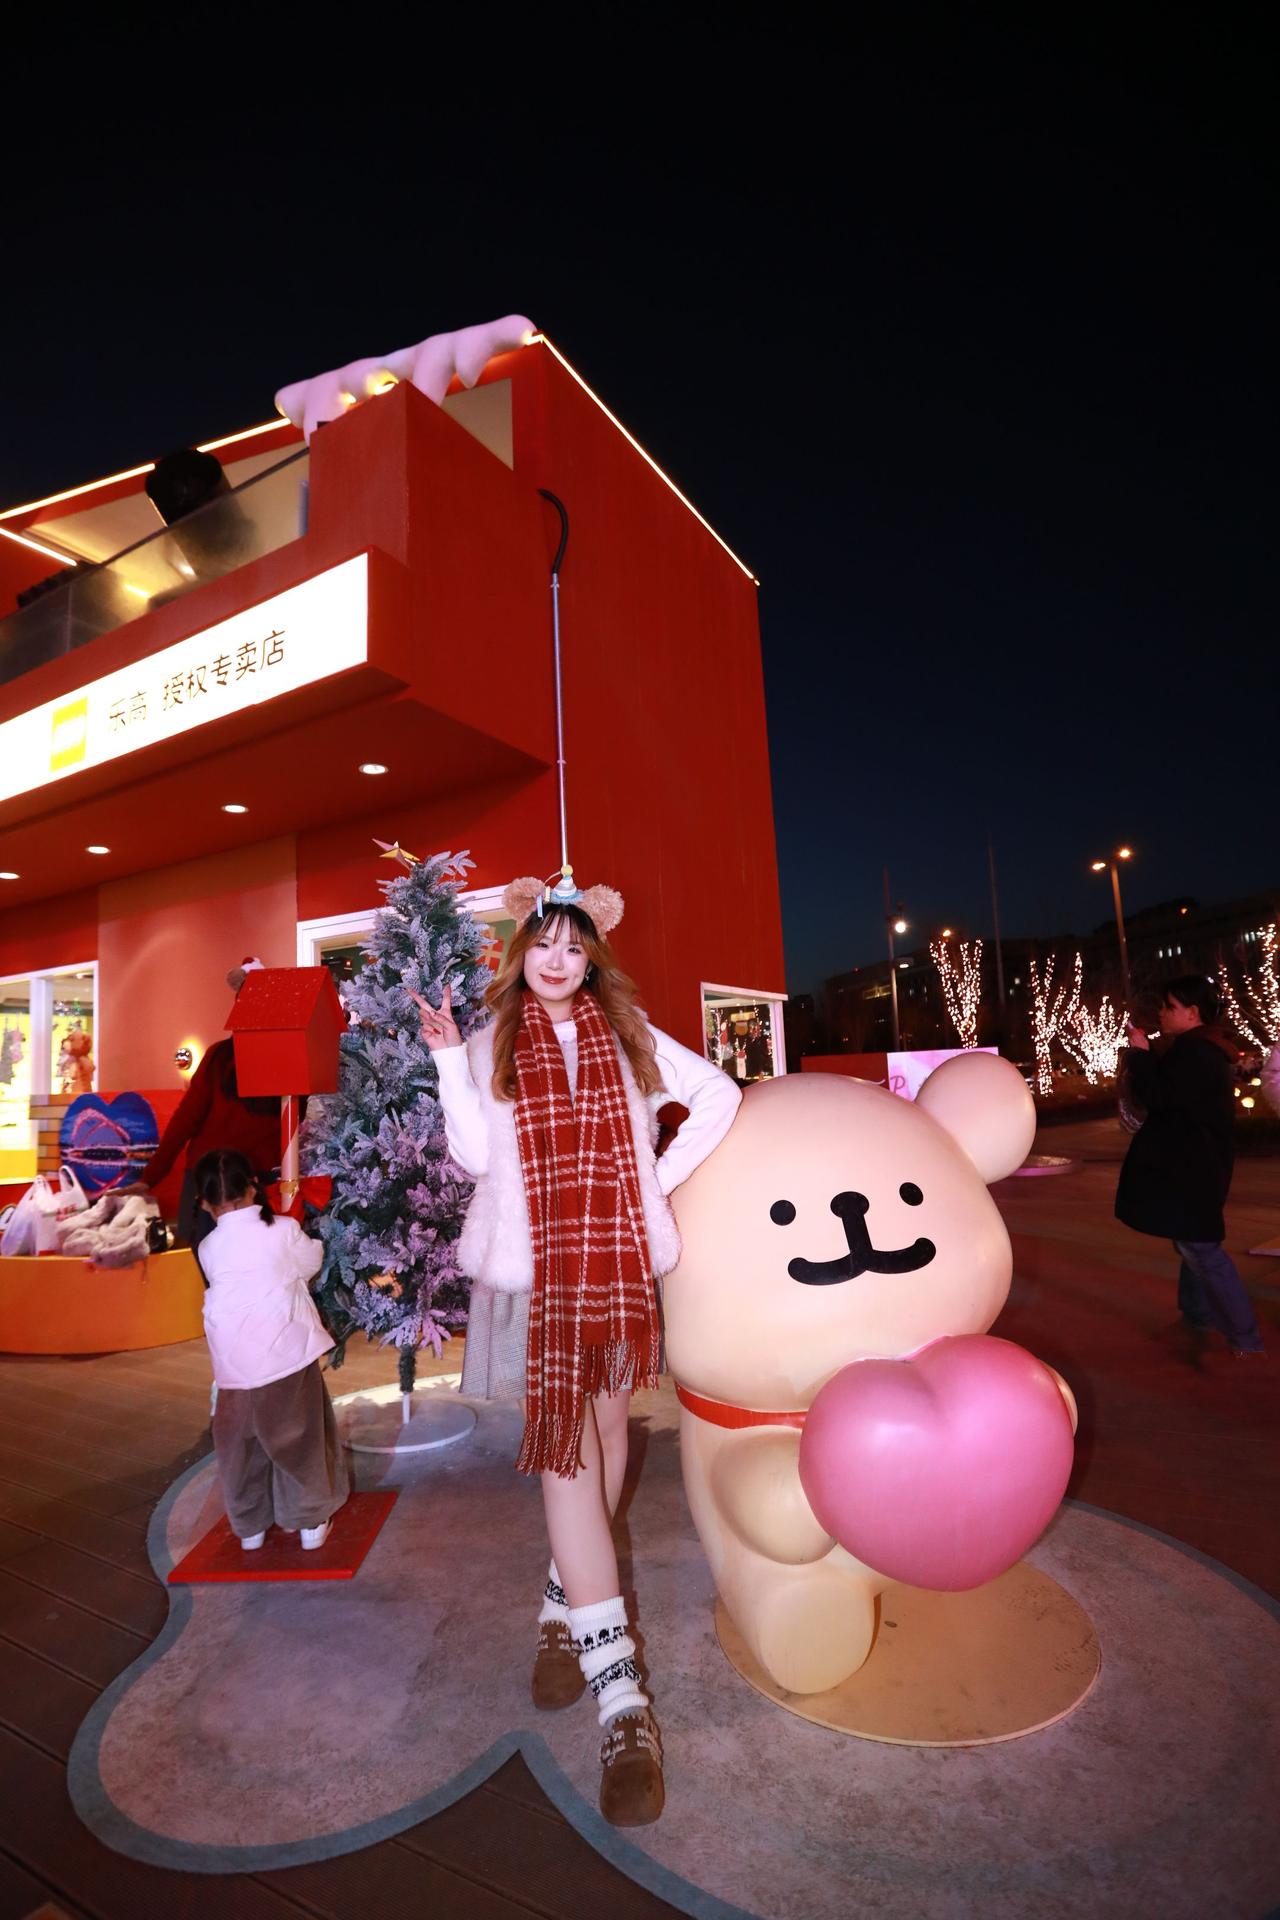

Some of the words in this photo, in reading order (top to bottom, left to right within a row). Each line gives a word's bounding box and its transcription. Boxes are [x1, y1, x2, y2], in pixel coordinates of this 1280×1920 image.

[162, 629, 286, 712] 授权专卖店
